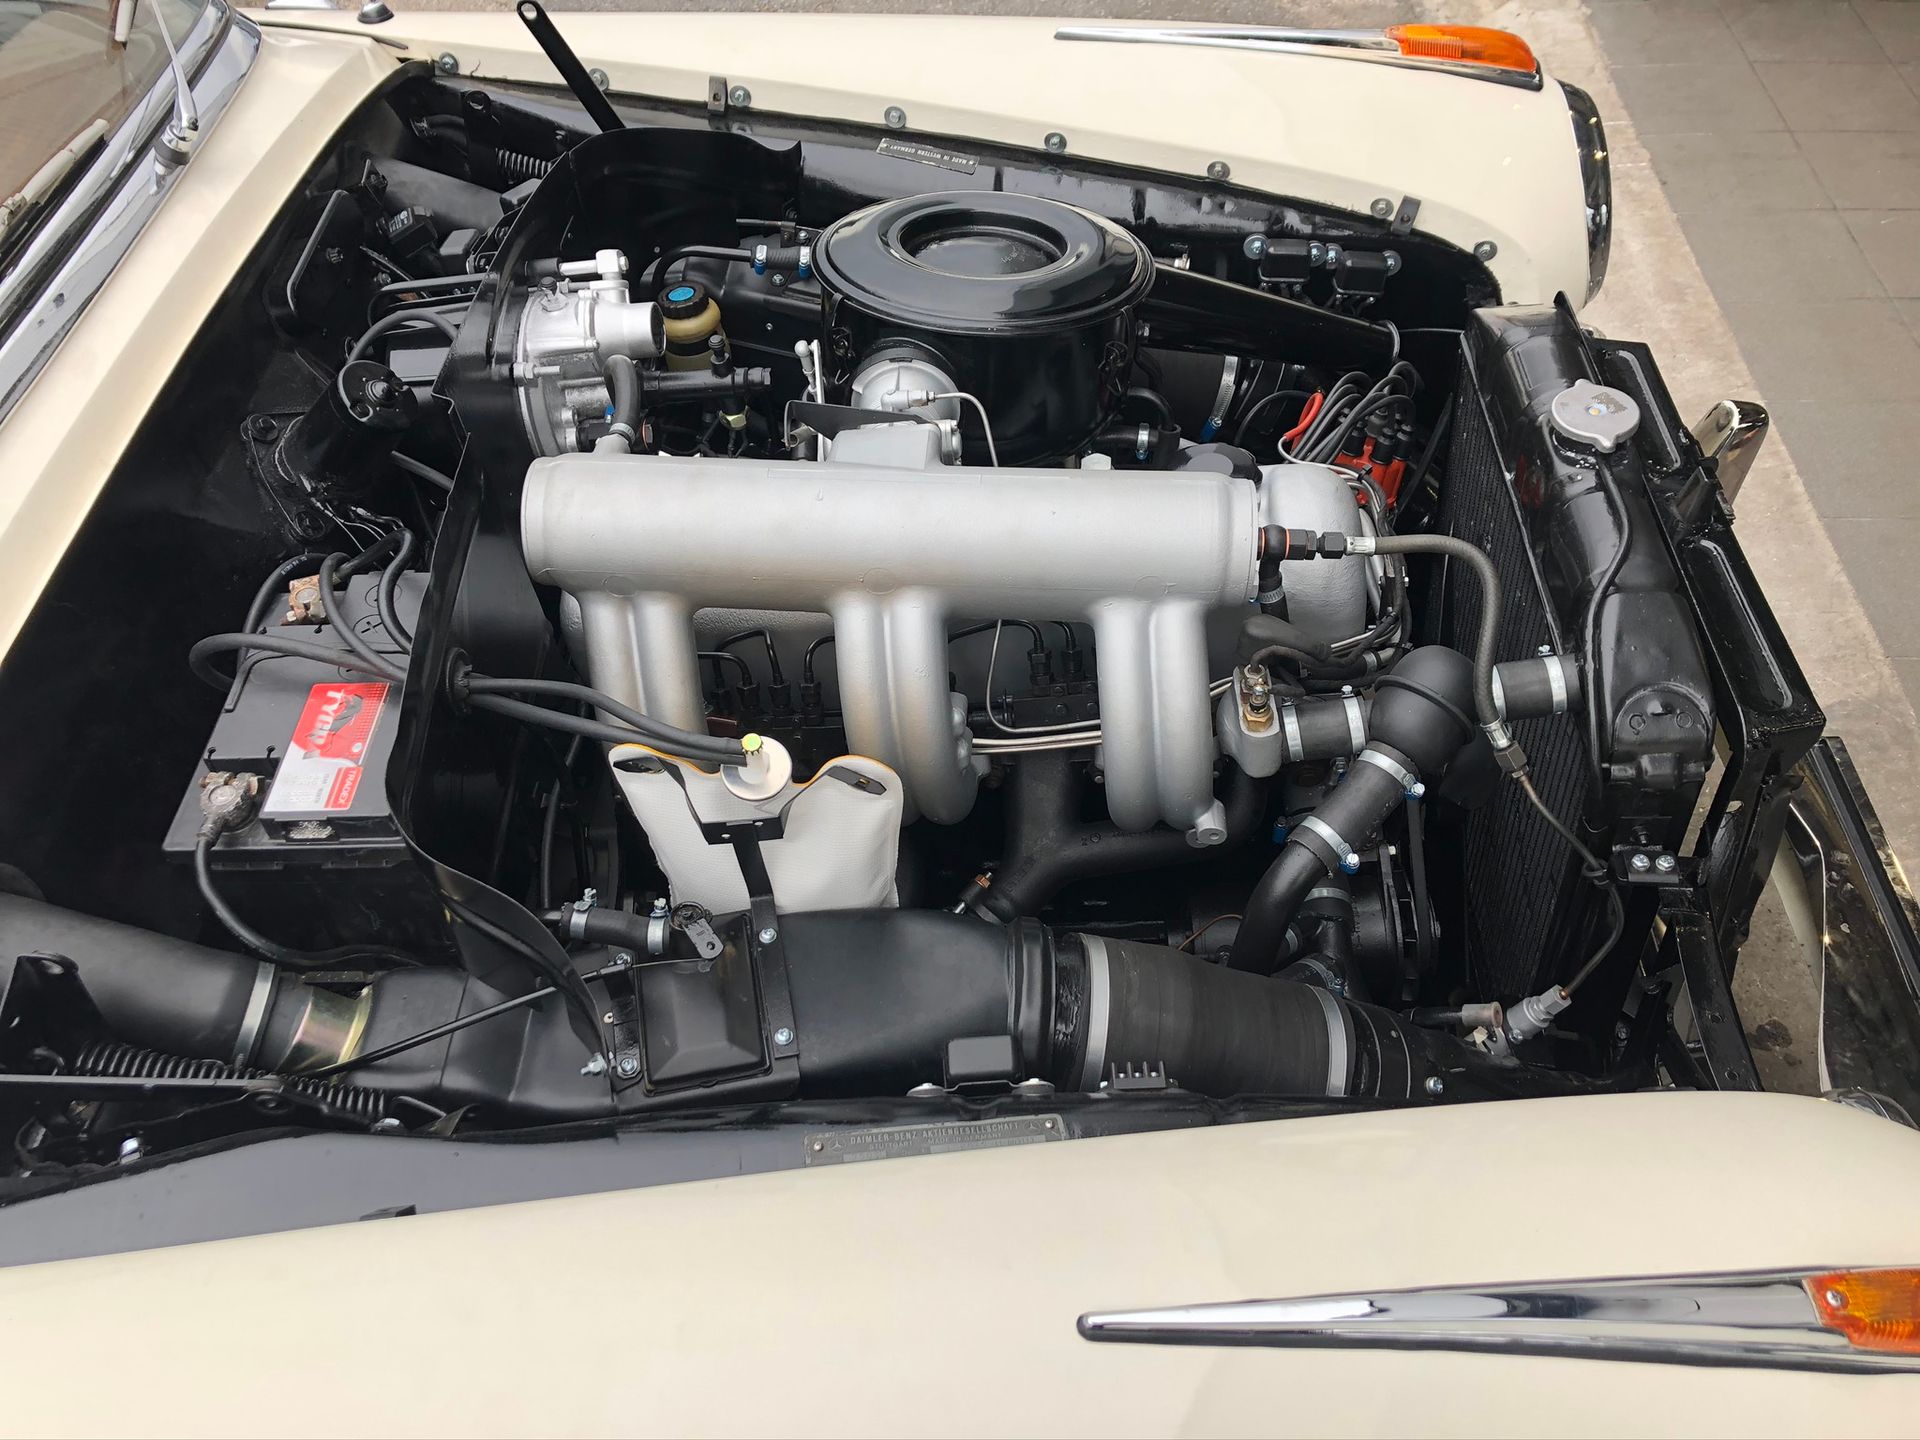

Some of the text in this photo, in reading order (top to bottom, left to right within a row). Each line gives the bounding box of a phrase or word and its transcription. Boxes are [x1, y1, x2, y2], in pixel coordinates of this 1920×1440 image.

[890, 144, 916, 154] GERMANY
[917, 149, 942, 159] WESTERN
[951, 156, 967, 164] MADE
[338, 768, 357, 805] TRADEX
[850, 1131, 917, 1144] DAIMLER-BENZ
[922, 1122, 1019, 1138] AKTIENGESELLSCHAFT
